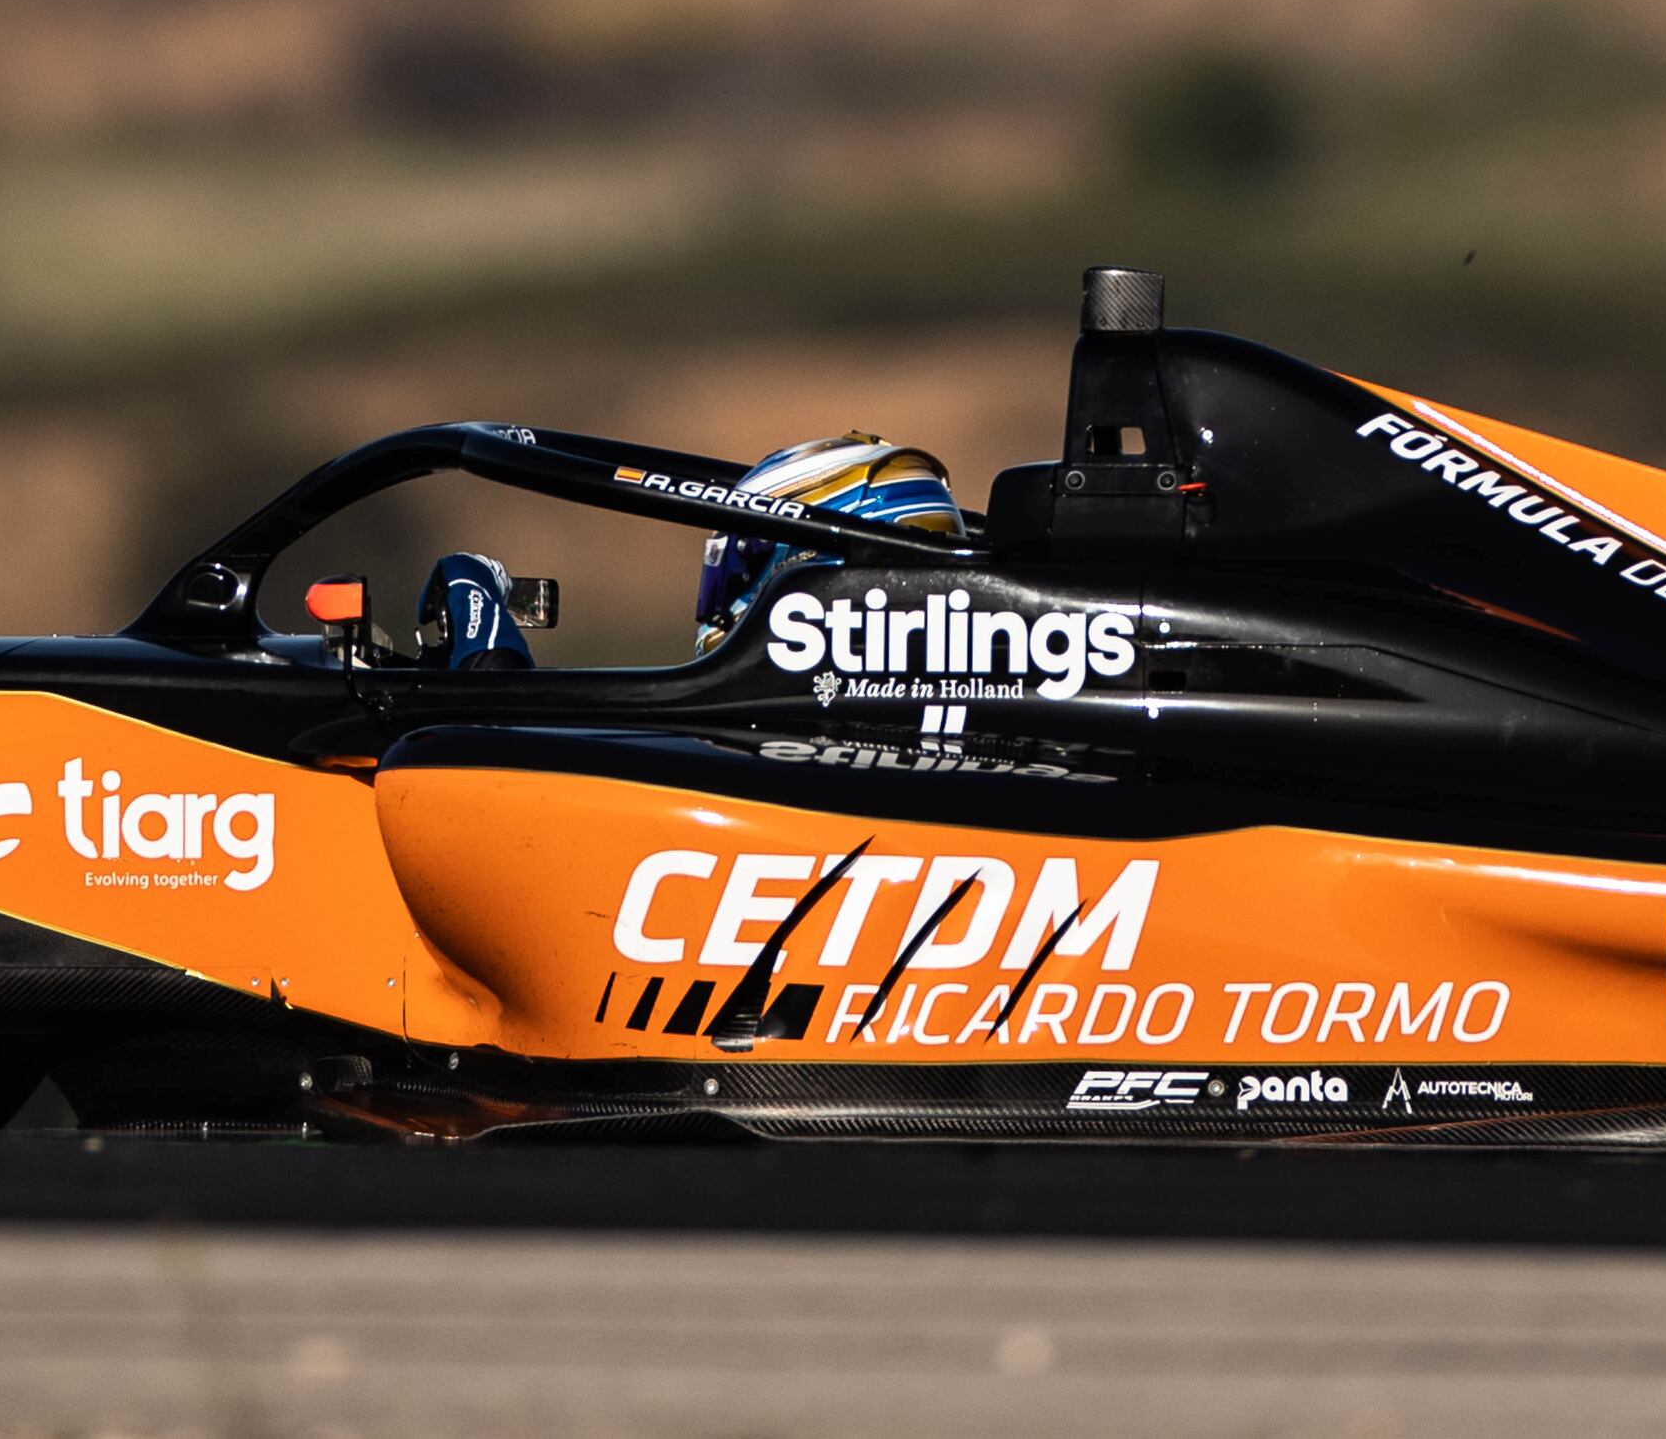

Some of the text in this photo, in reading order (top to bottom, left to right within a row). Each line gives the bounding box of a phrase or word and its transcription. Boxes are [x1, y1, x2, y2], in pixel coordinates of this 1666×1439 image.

[1356, 412, 1624, 566] FÓRMULA
[767, 588, 1136, 702] Stirlings
[844, 677, 1025, 700] Made in Holland
[57, 757, 276, 892] tiarg
[85, 872, 219, 889] Evolving together
[613, 849, 1161, 973] CETDM
[825, 981, 1510, 1045] RICARDO TORMO
[1072, 1070, 1210, 1096] PFC
[1235, 1069, 1348, 1110] panta
[1417, 1080, 1523, 1095] AUTOTECNICA
